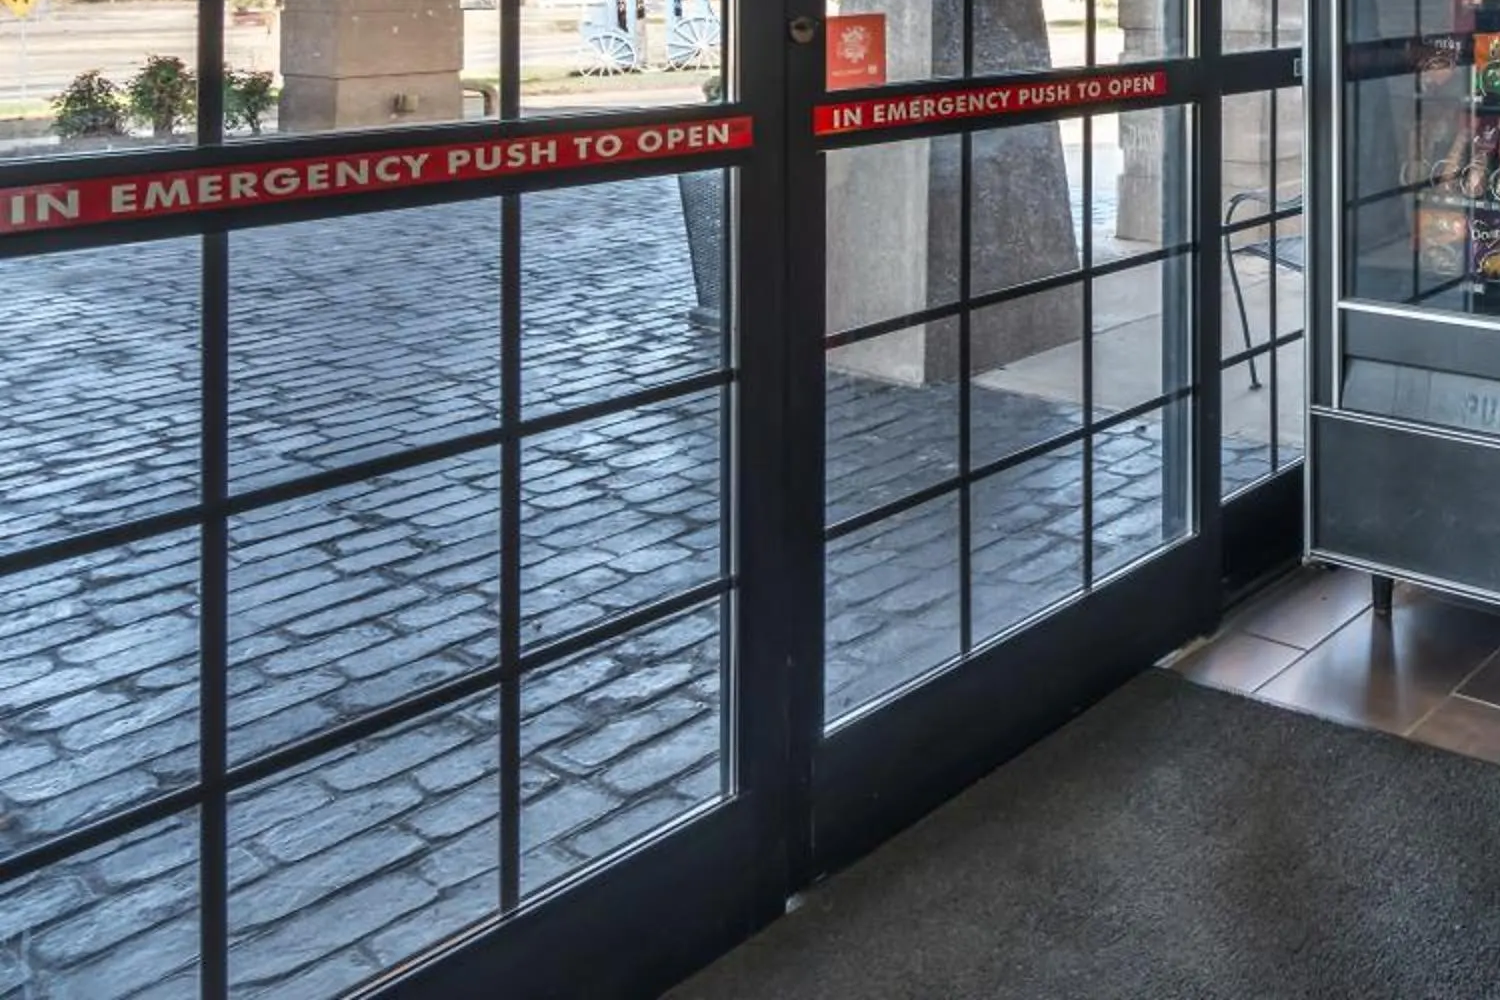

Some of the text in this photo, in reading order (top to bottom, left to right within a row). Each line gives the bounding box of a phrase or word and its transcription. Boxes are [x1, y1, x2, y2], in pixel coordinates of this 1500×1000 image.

[833, 75, 1156, 129] IN EMERGENCY PUSH TO OPEN
[11, 124, 730, 225] IN EMERGENCY PUSH TO OPEN
